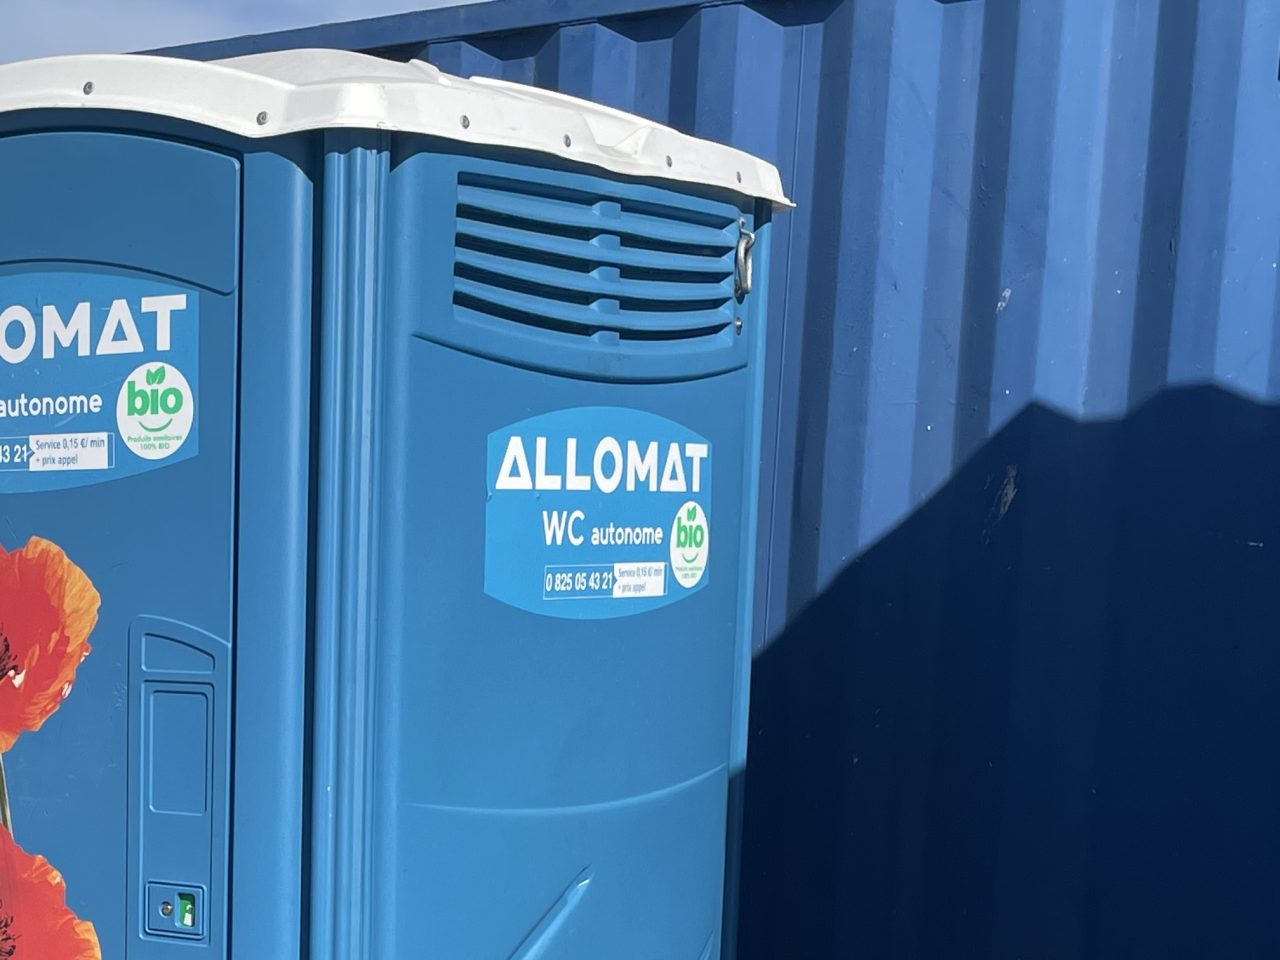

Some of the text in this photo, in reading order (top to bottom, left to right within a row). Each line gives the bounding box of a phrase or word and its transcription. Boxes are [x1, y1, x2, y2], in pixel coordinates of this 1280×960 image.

[127, 381, 183, 416] bio
[14, 444, 27, 462] 21
[35, 440, 61, 450] Service
[63, 438, 78, 450] 0,15
[42, 456, 56, 467] prix
[58, 455, 79, 465] appel
[495, 436, 708, 494] ALLOMAT
[542, 510, 663, 546] WC autonome
[676, 516, 704, 548] bio
[545, 571, 613, 591] 0 825 05 43 21
